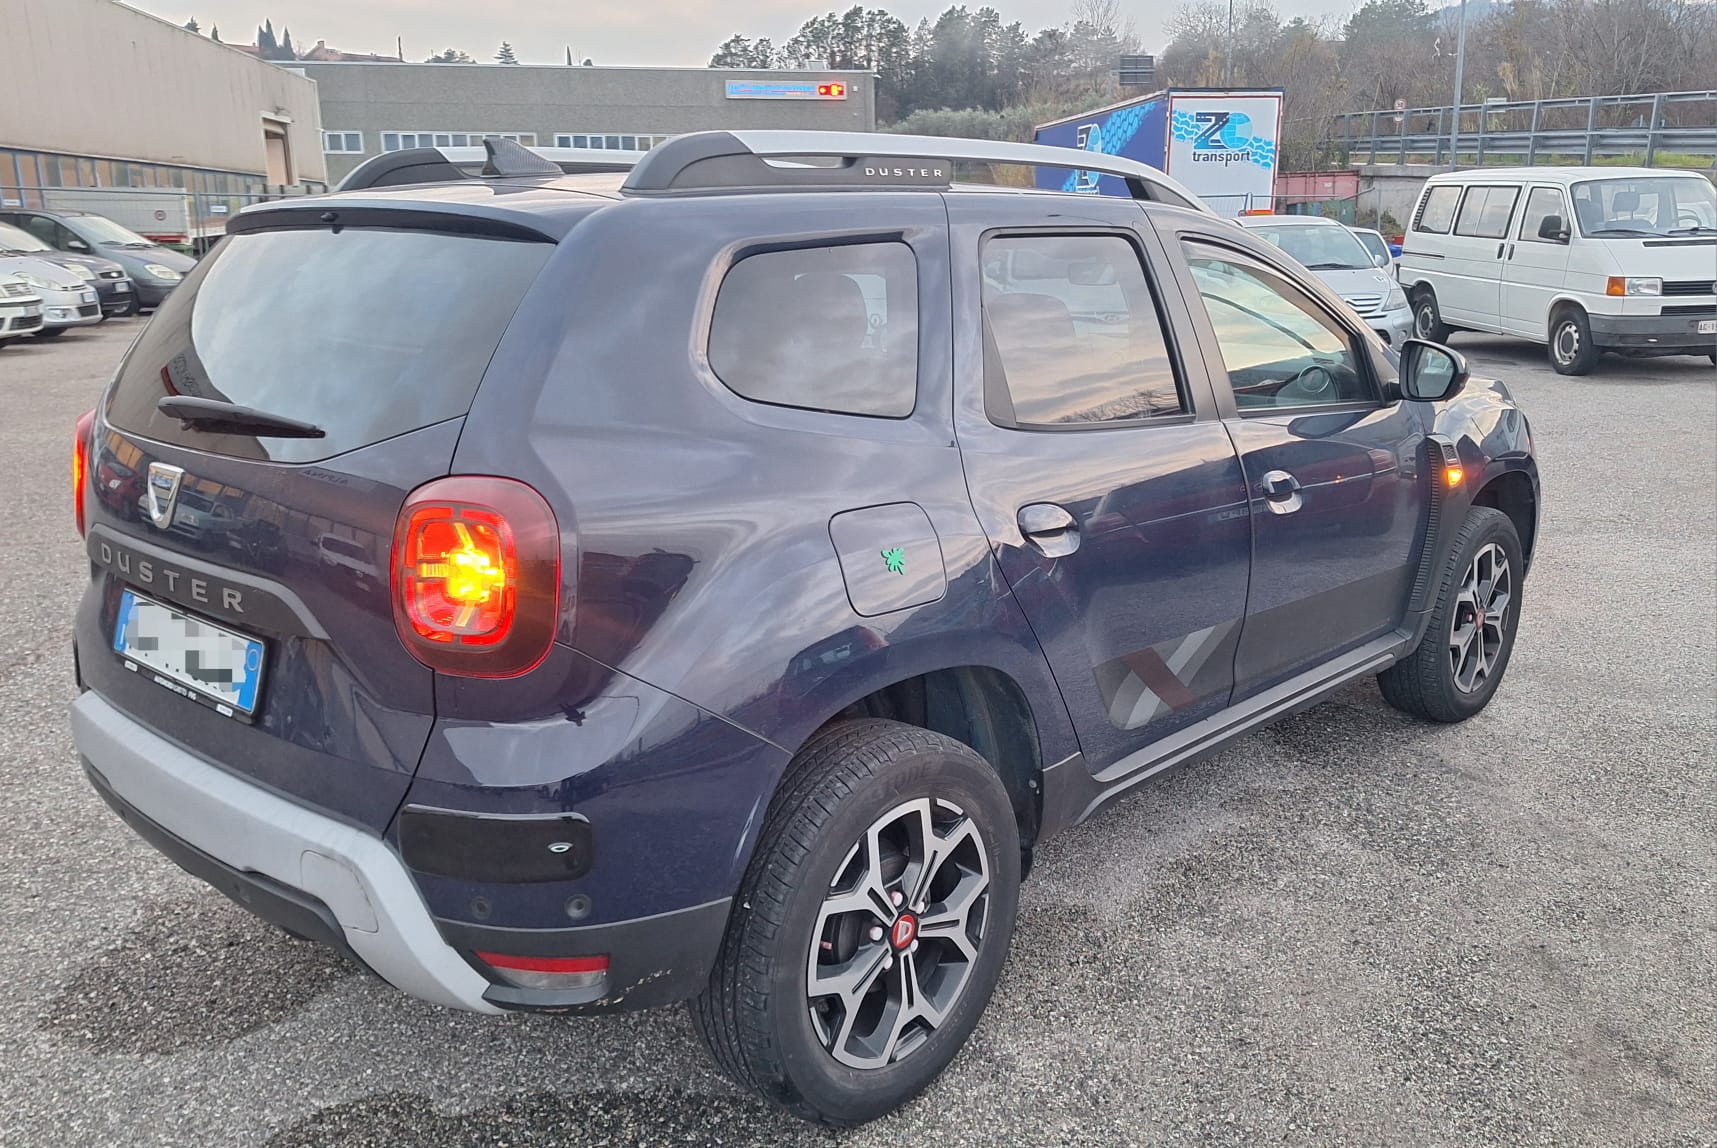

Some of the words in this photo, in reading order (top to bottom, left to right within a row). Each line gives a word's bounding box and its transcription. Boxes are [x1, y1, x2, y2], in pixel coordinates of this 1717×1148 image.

[1192, 151, 1250, 167] transport
[864, 167, 943, 177] DUSTER
[100, 542, 245, 613] DUSTER
